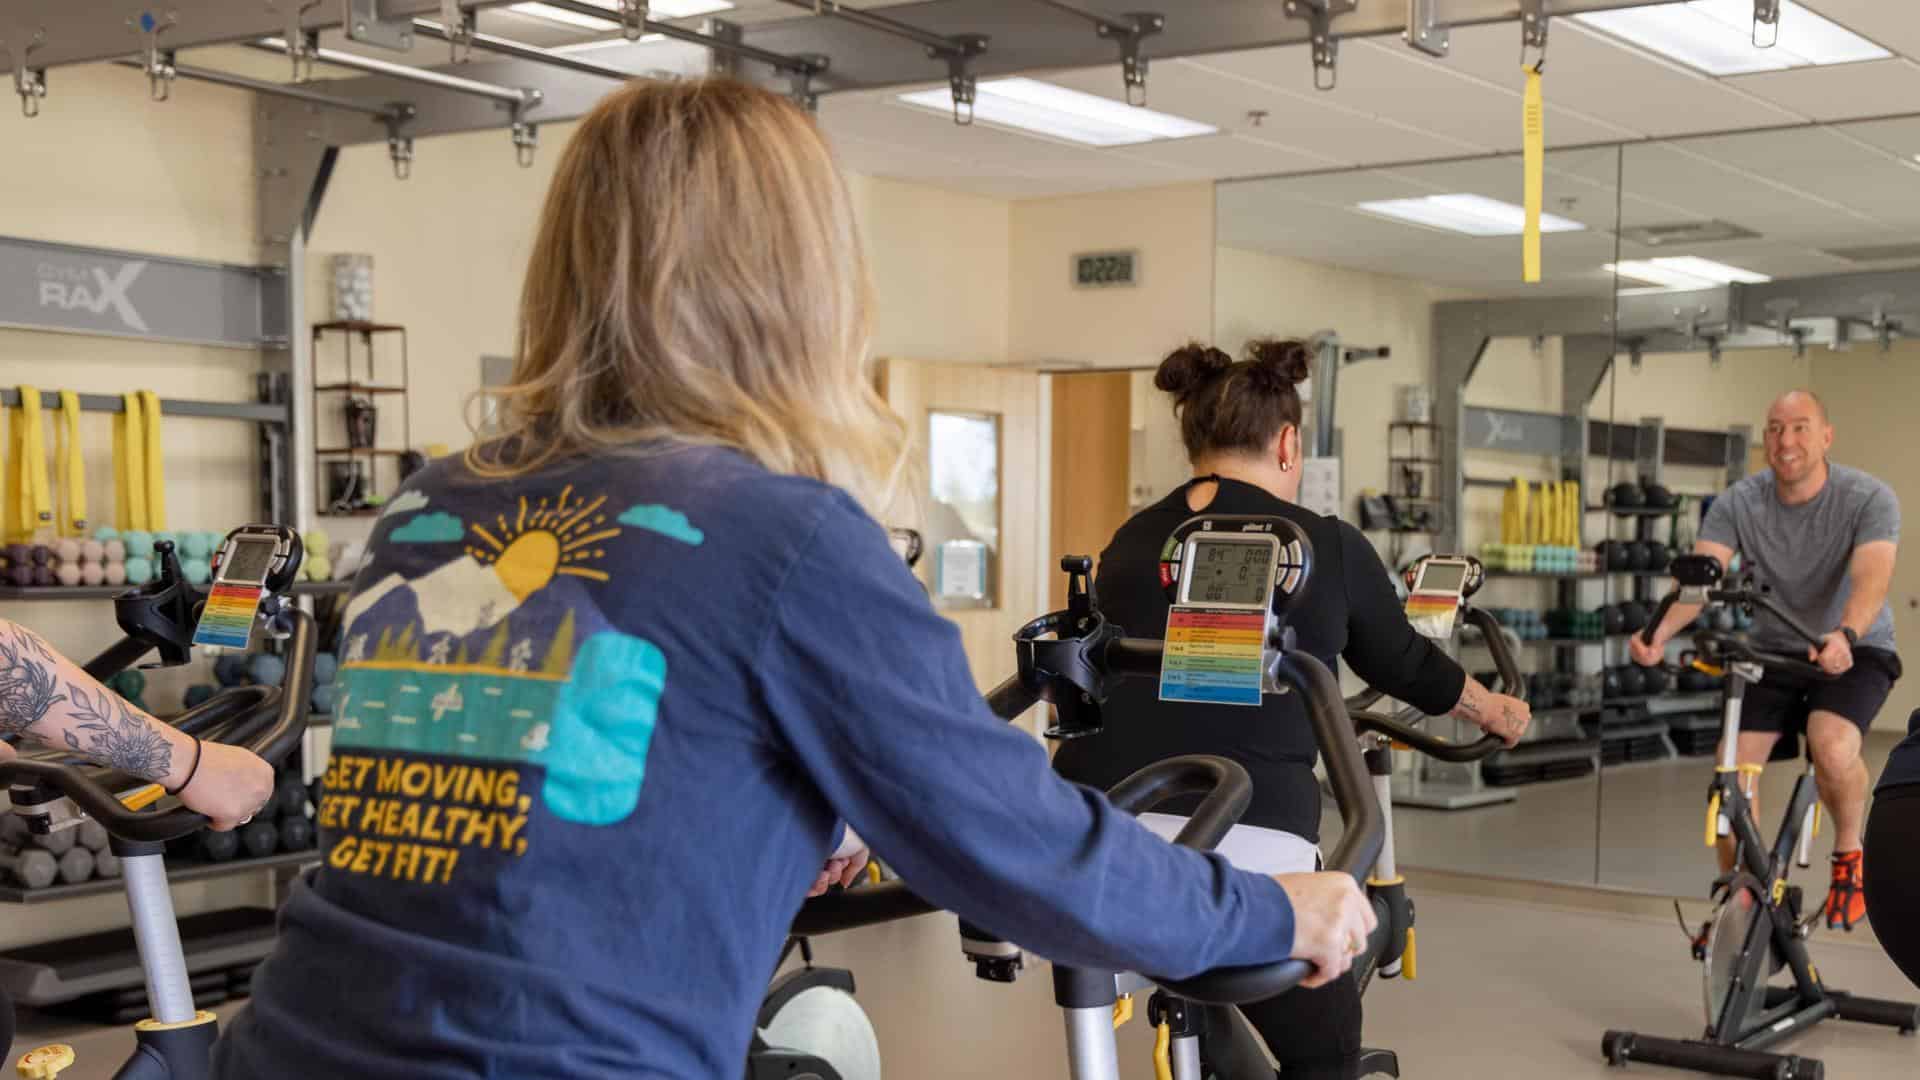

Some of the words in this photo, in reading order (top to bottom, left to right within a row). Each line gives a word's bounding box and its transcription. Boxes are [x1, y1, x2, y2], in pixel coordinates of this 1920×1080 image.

[322, 755, 374, 790] GET
[376, 758, 532, 813] MOVING,
[361, 797, 528, 857] HEALTHY,
[329, 836, 392, 876] GET
[392, 842, 459, 885] FIT!
